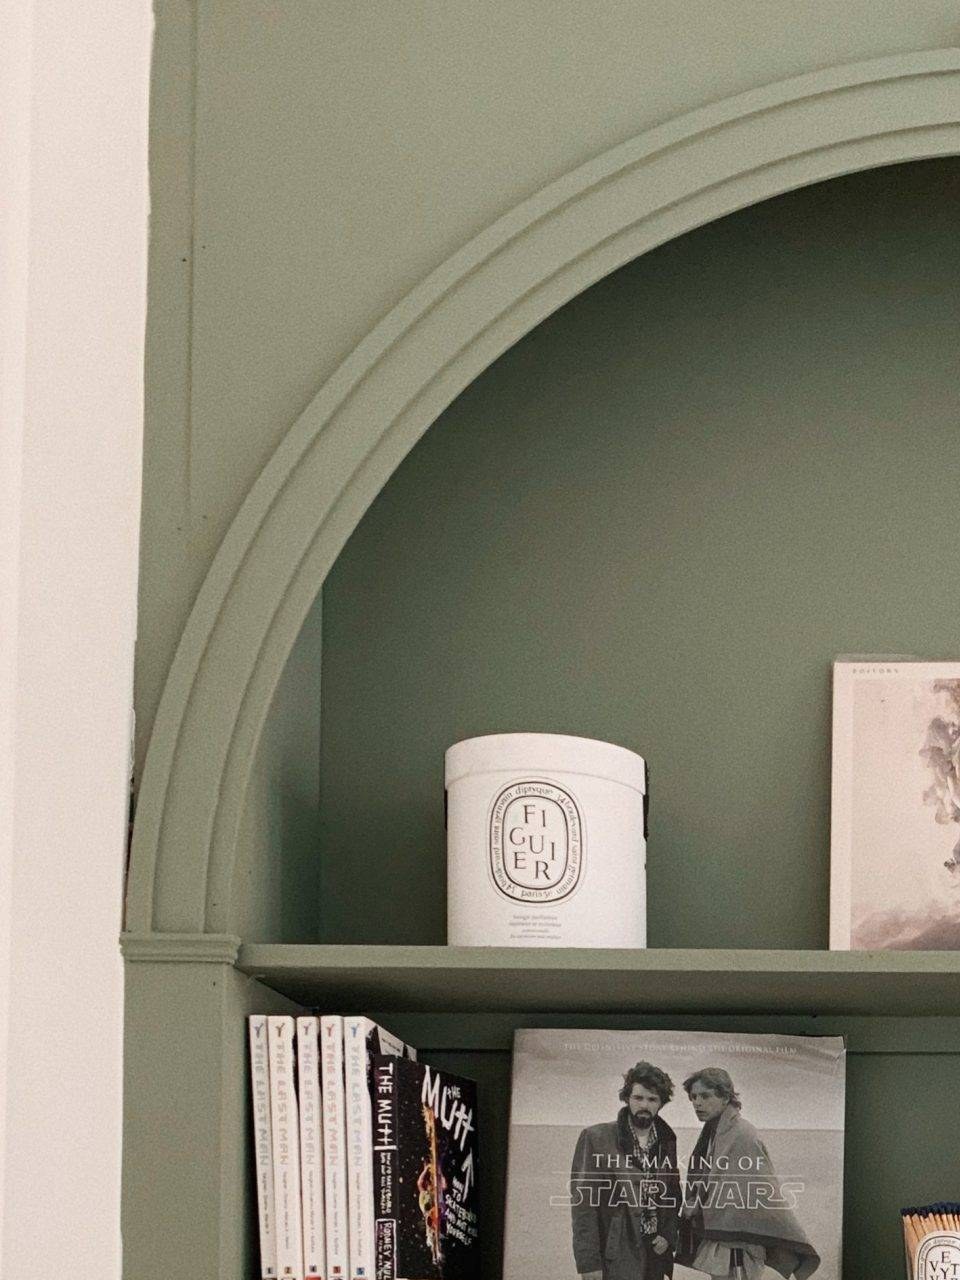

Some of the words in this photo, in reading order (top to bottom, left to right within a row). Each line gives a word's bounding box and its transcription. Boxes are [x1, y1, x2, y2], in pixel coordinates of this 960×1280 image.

[377, 1062, 393, 1094] THE
[592, 1153, 634, 1169] THE
[642, 1154, 730, 1171] MAKING
[738, 1155, 765, 1171] OF
[550, 1178, 677, 1208] STAR
[679, 1180, 805, 1210] WARS
